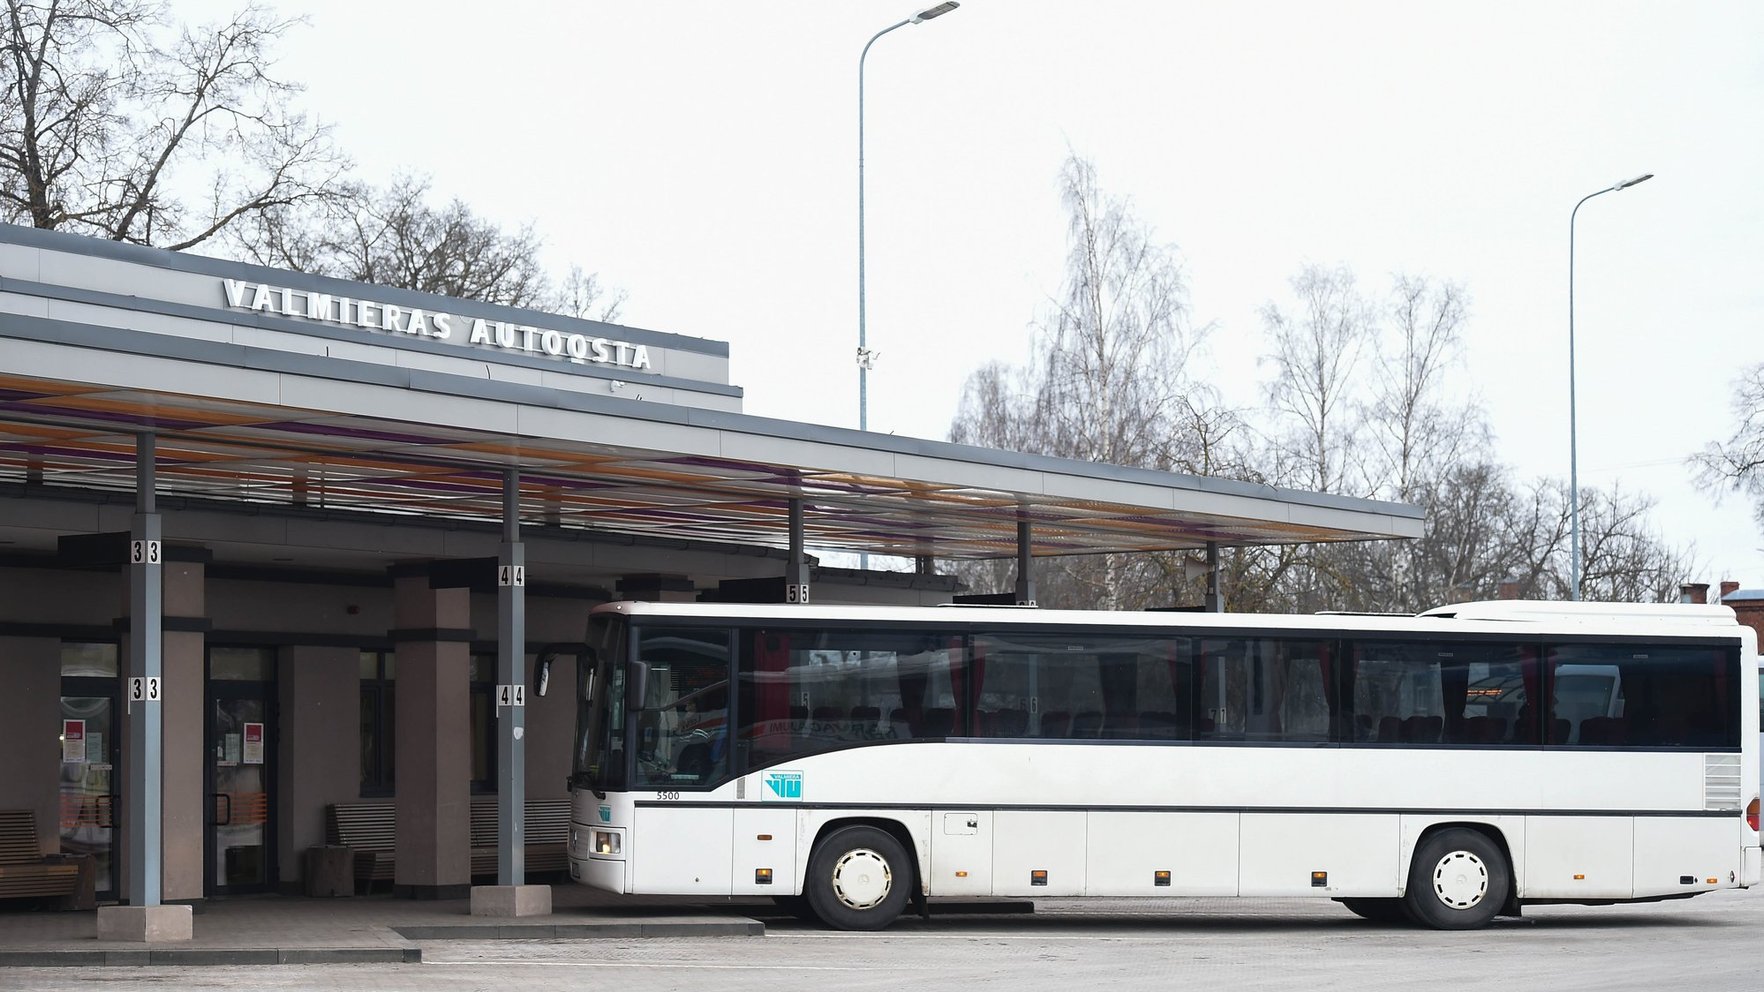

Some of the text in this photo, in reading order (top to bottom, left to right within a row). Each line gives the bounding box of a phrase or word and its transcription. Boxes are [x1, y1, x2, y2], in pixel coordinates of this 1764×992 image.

[223, 278, 651, 370] VALMIERAS AUTOOSTA
[134, 541, 141, 562] 3
[150, 541, 158, 562] 3
[501, 566, 509, 585] 4
[516, 567, 522, 585] 4
[789, 585, 796, 602] 5
[802, 585, 807, 602] 5
[133, 678, 141, 699] 3
[150, 678, 157, 699] 3
[501, 686, 509, 705] 4
[516, 686, 522, 705] 4
[656, 791, 680, 801] 5500
